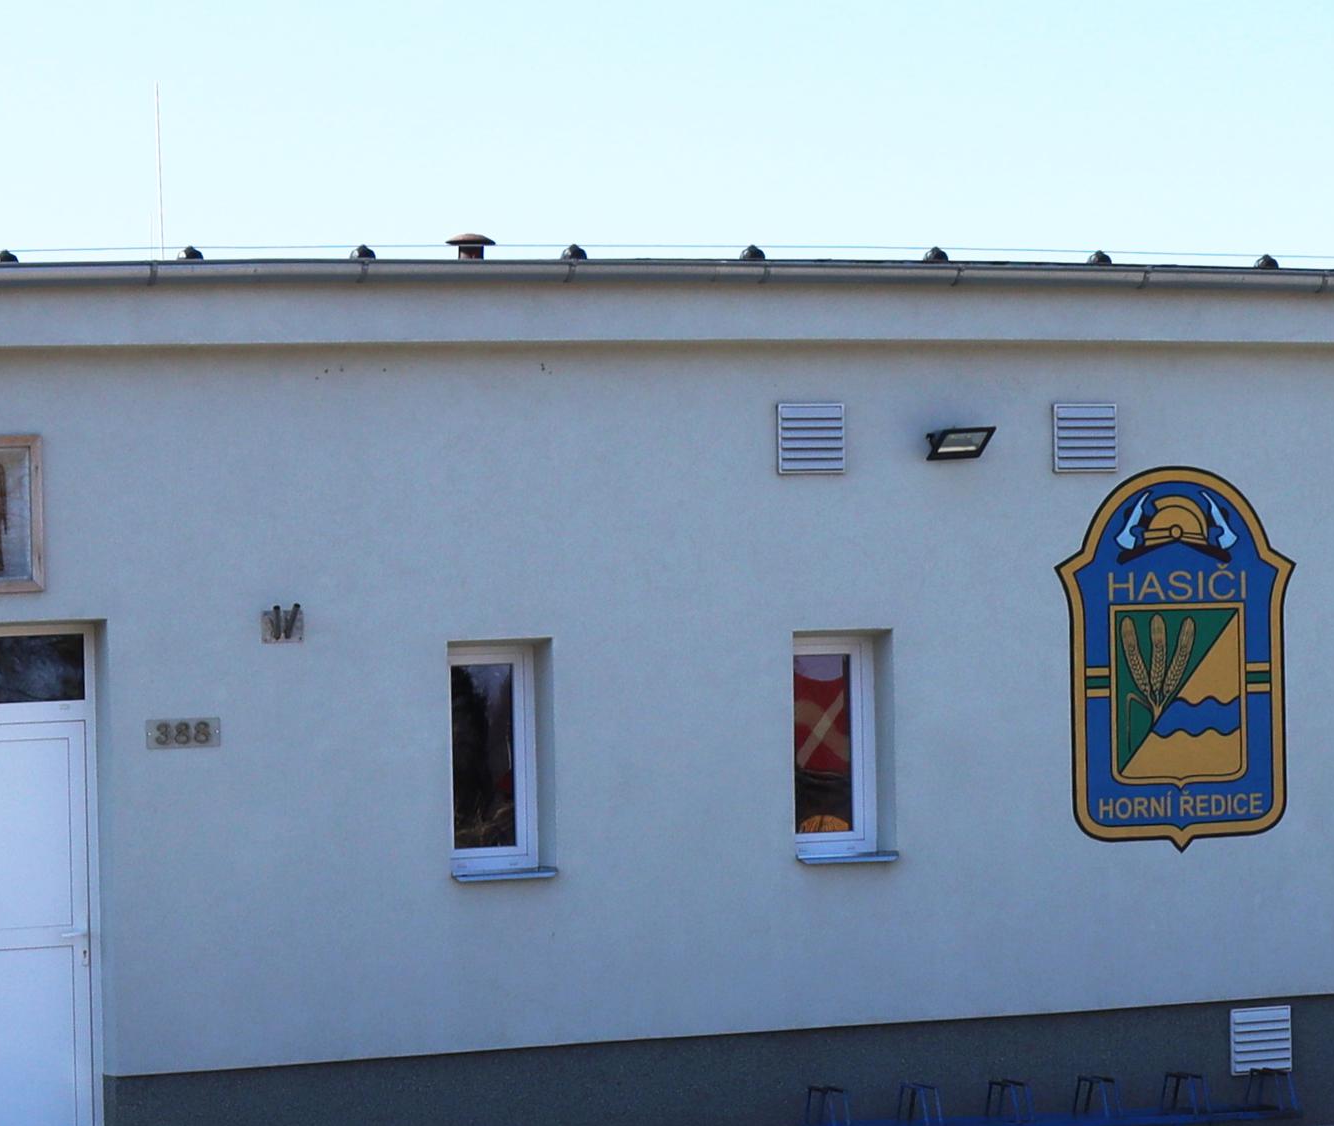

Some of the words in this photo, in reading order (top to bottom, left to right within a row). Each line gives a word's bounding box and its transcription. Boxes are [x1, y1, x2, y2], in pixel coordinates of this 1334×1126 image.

[1108, 563, 1247, 601] HASIČI
[155, 721, 211, 745] 388
[1099, 791, 1171, 819] HORNÍ
[1179, 790, 1263, 817] ŘEDICE
